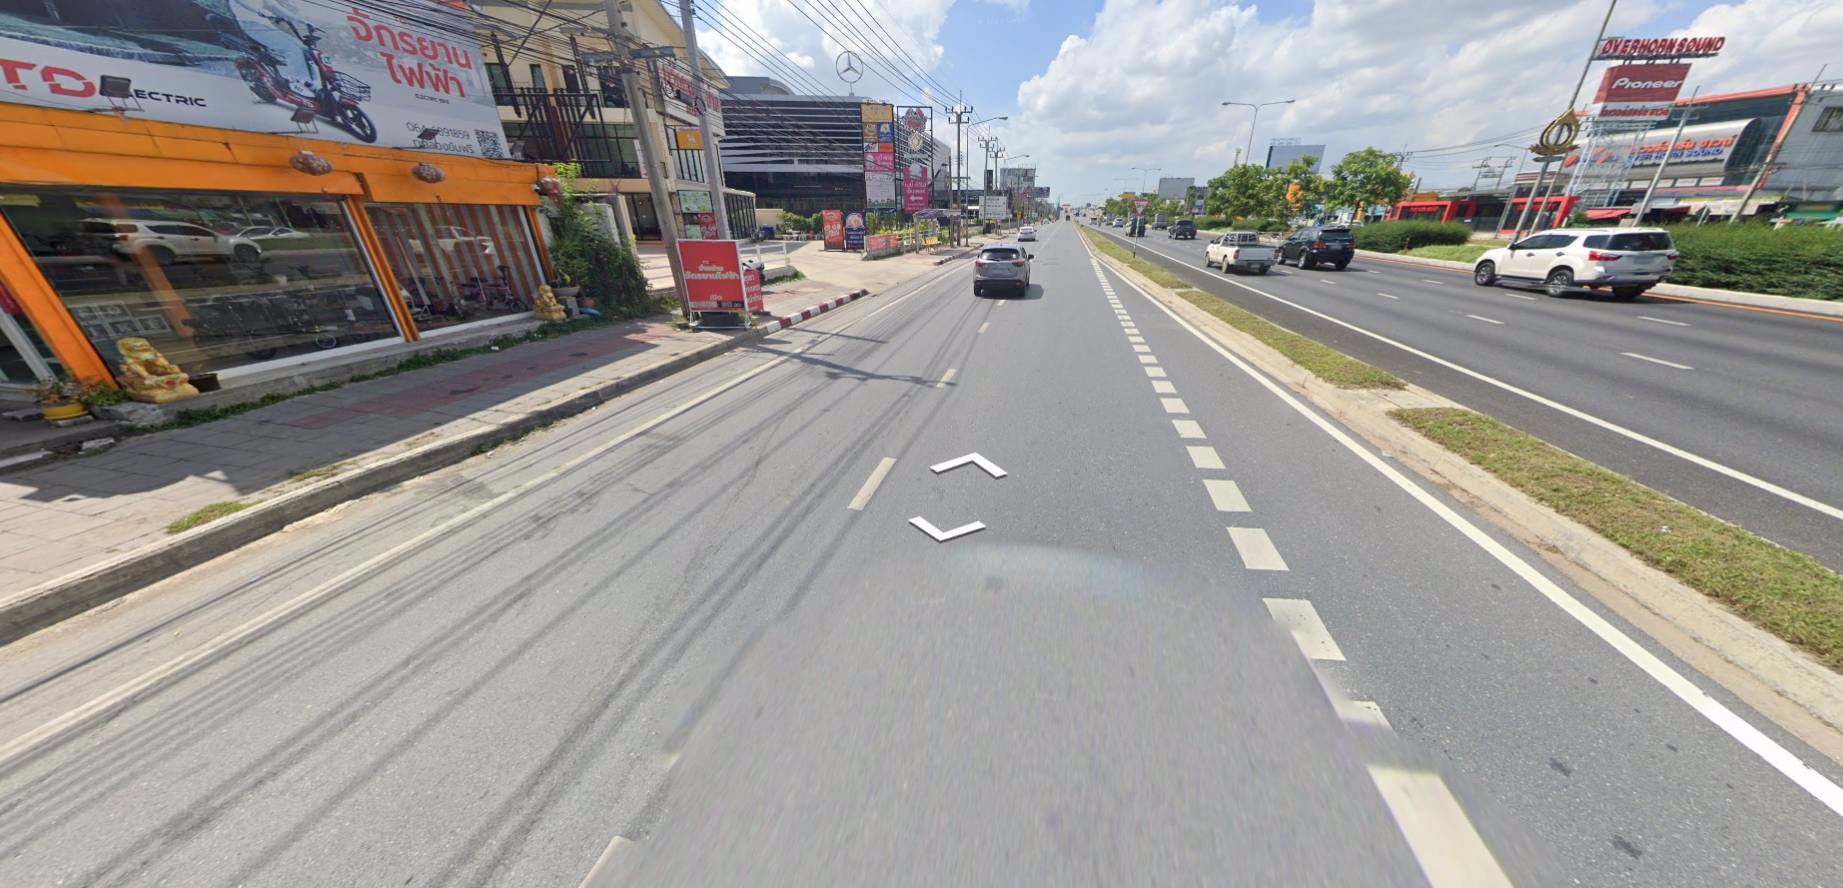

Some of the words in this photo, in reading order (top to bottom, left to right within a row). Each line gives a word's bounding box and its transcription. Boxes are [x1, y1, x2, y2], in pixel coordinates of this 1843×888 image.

[347, 7, 473, 70] จักรยาน
[1676, 36, 1726, 53] SOUND
[380, 52, 465, 98] ไฟฟ้า
[1611, 77, 1684, 90] Pioneer
[128, 87, 207, 108] ECTRIC
